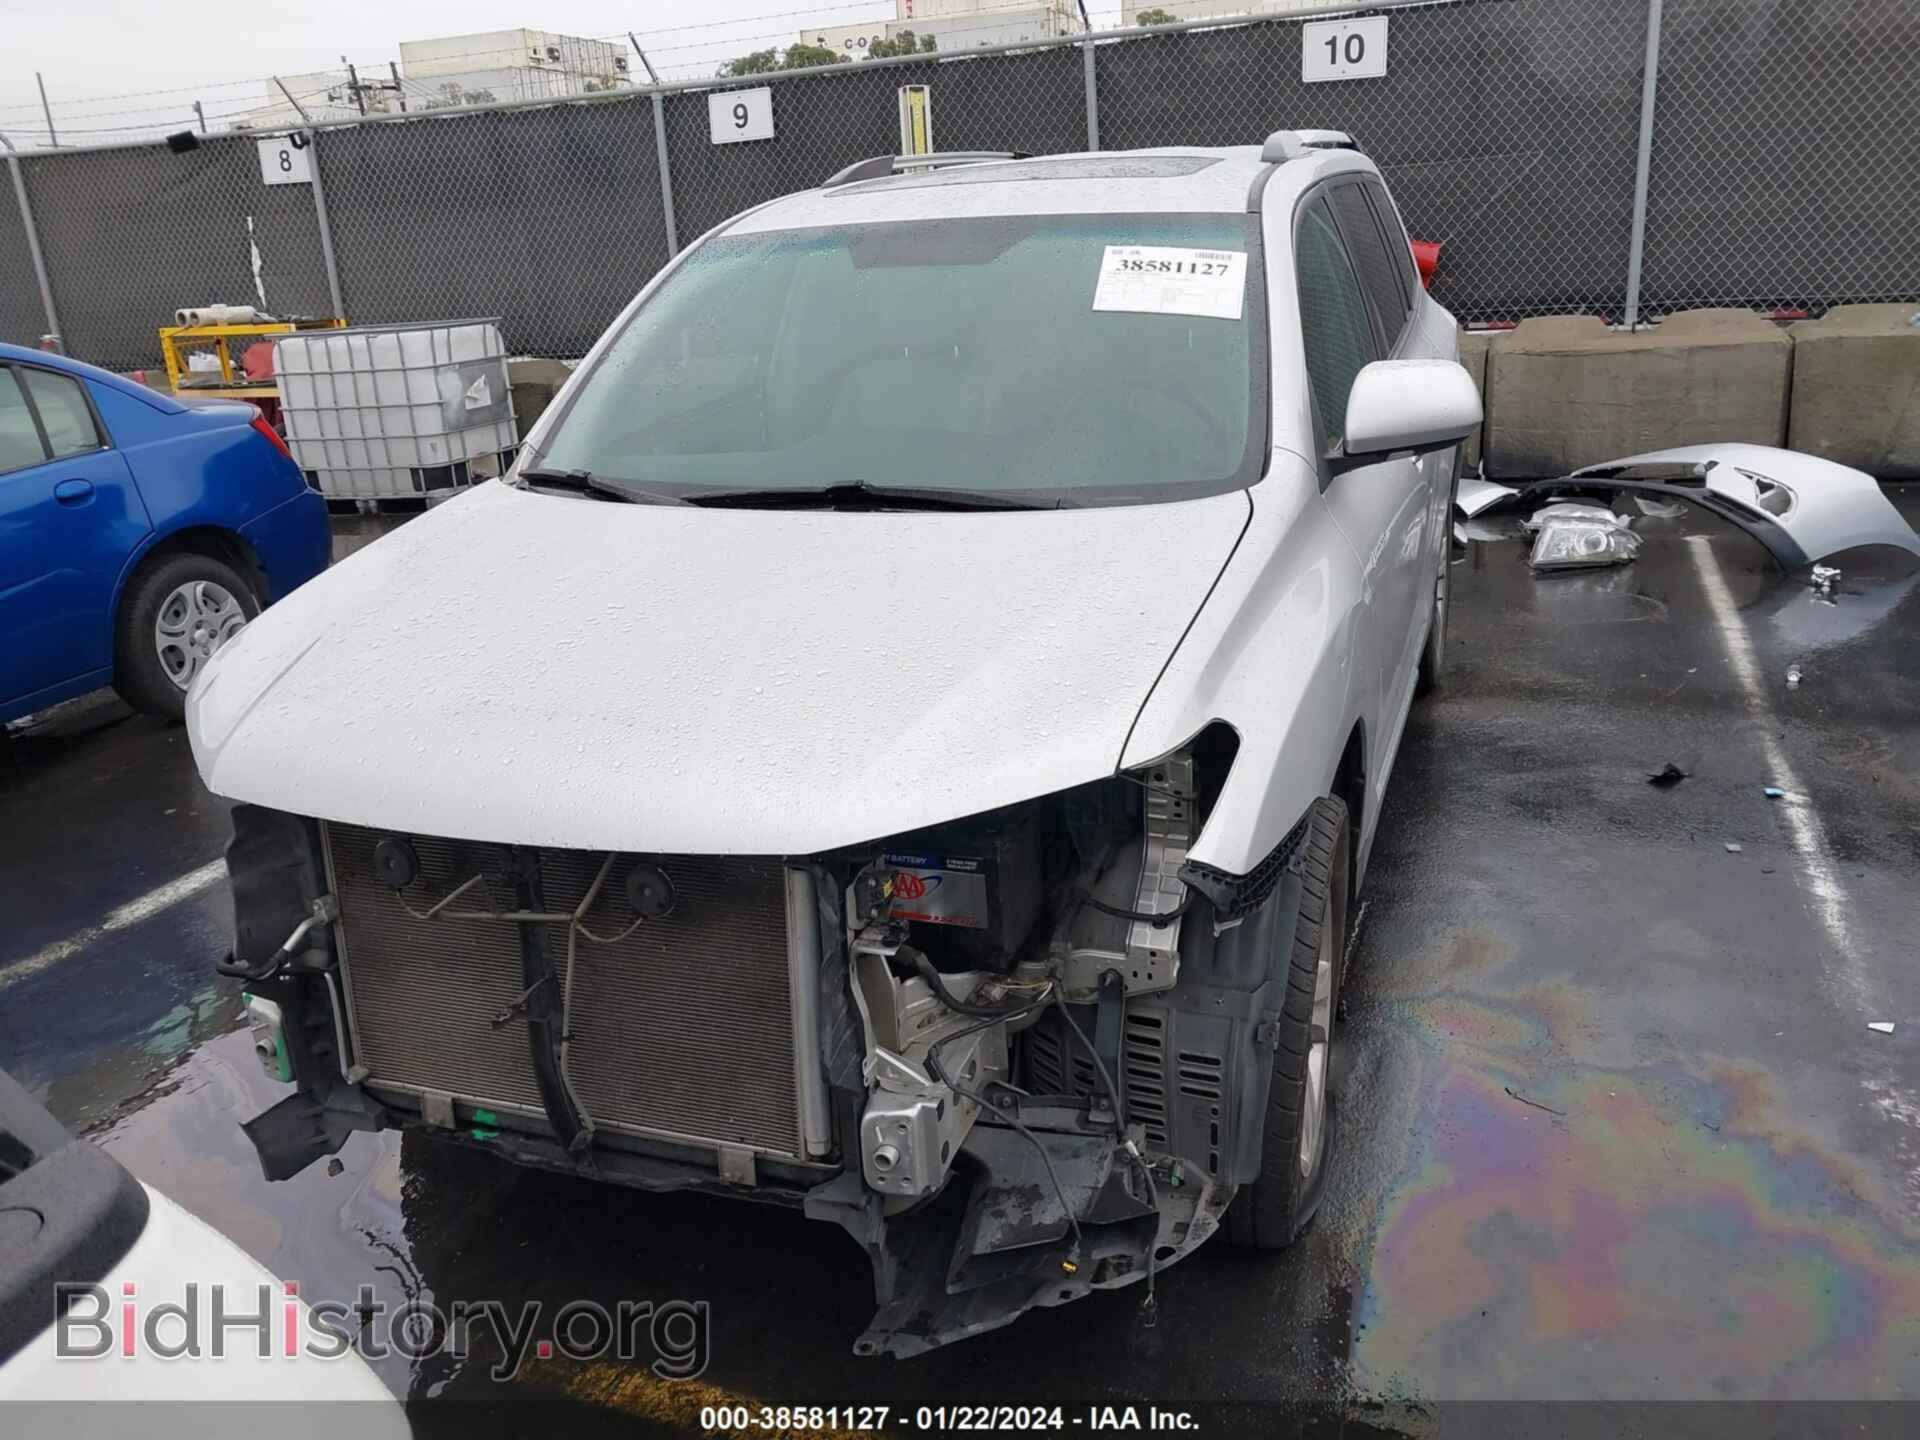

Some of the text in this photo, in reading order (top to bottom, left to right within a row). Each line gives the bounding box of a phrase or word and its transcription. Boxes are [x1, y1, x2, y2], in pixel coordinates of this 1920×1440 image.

[1324, 33, 1365, 66] 10
[733, 103, 749, 129] 9
[279, 150, 292, 172] 8
[1116, 259, 1230, 276] 38581127
